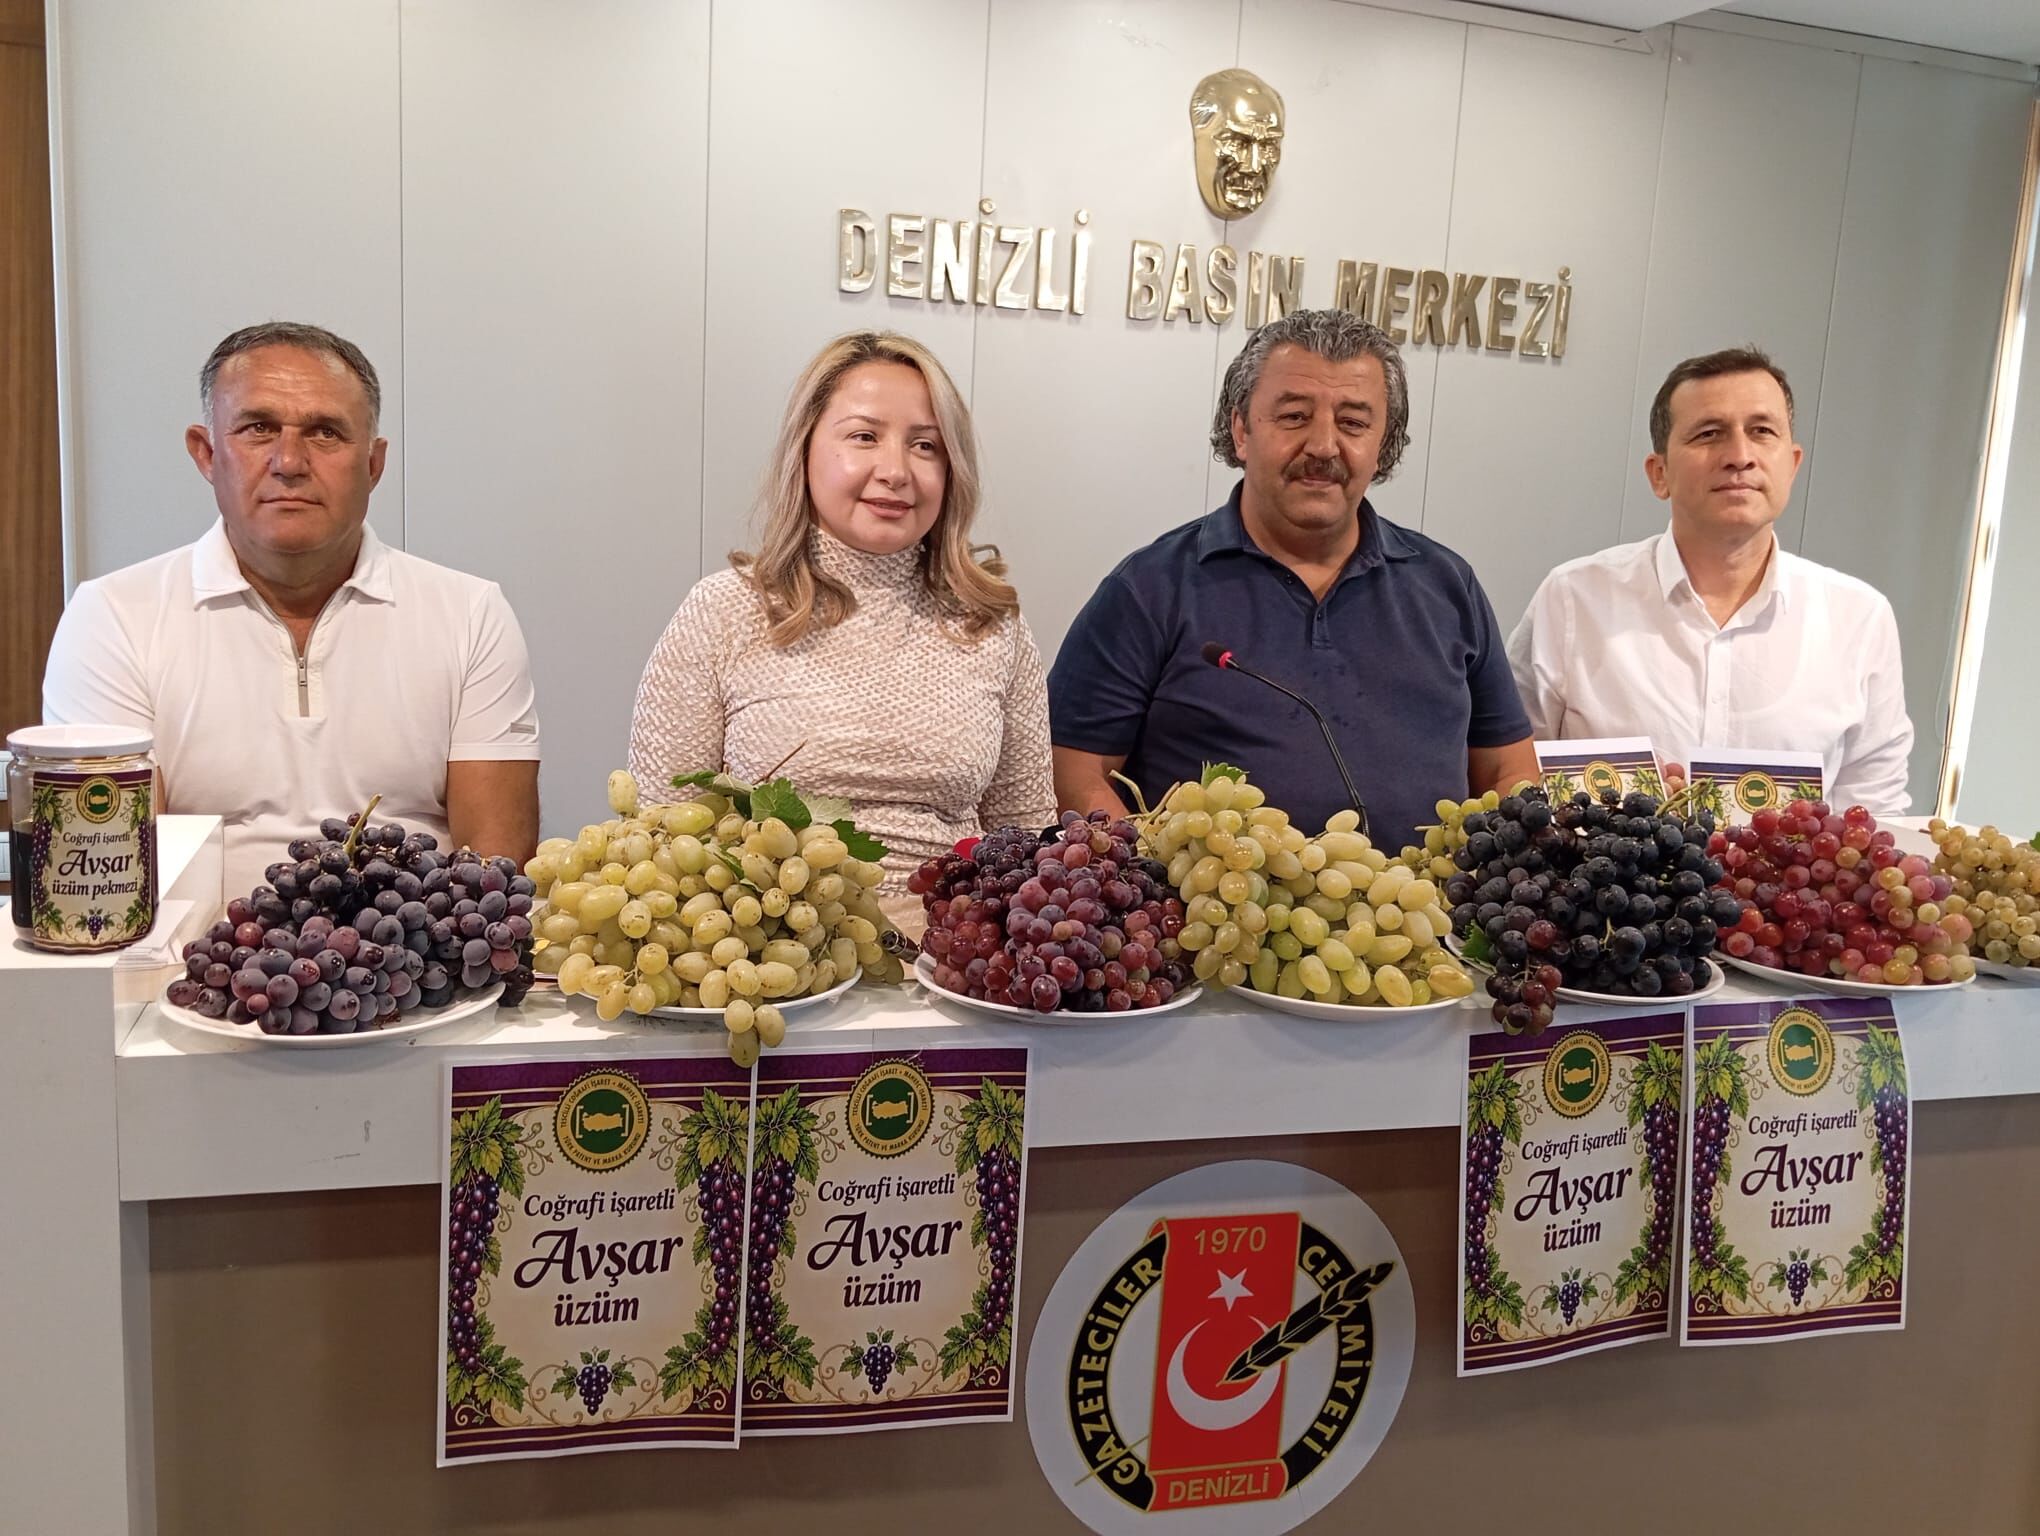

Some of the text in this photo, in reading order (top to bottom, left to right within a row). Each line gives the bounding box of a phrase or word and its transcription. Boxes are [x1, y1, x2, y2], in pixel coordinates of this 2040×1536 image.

[839, 199, 1572, 358] DENİZLİ BASIN MERKEZİ
[62, 830, 131, 846] Coğrafi işaretli
[58, 849, 134, 879] Avşar
[52, 877, 138, 900] üzüm pekmezi
[1747, 1109, 1857, 1138] Coğrafi işaretli
[1521, 1126, 1628, 1164] Coğrafi işaretli
[1740, 1143, 1864, 1196] Avşar
[524, 1189, 675, 1222] Coğrafi işaretli
[817, 1173, 956, 1206] Coğrafi işaretli
[1513, 1166, 1633, 1222] Avşar
[1770, 1198, 1831, 1229] üzüm
[806, 1211, 963, 1270] Avşar
[1194, 1226, 1267, 1256] 1970
[1543, 1218, 1602, 1252] üzüm
[513, 1227, 683, 1288] Avşar
[843, 1273, 921, 1308] üzüm
[554, 1291, 640, 1327] üzüm
[1077, 1257, 1163, 1485] GAZETECİLER
[1168, 1466, 1270, 1504] DENİZLİ
